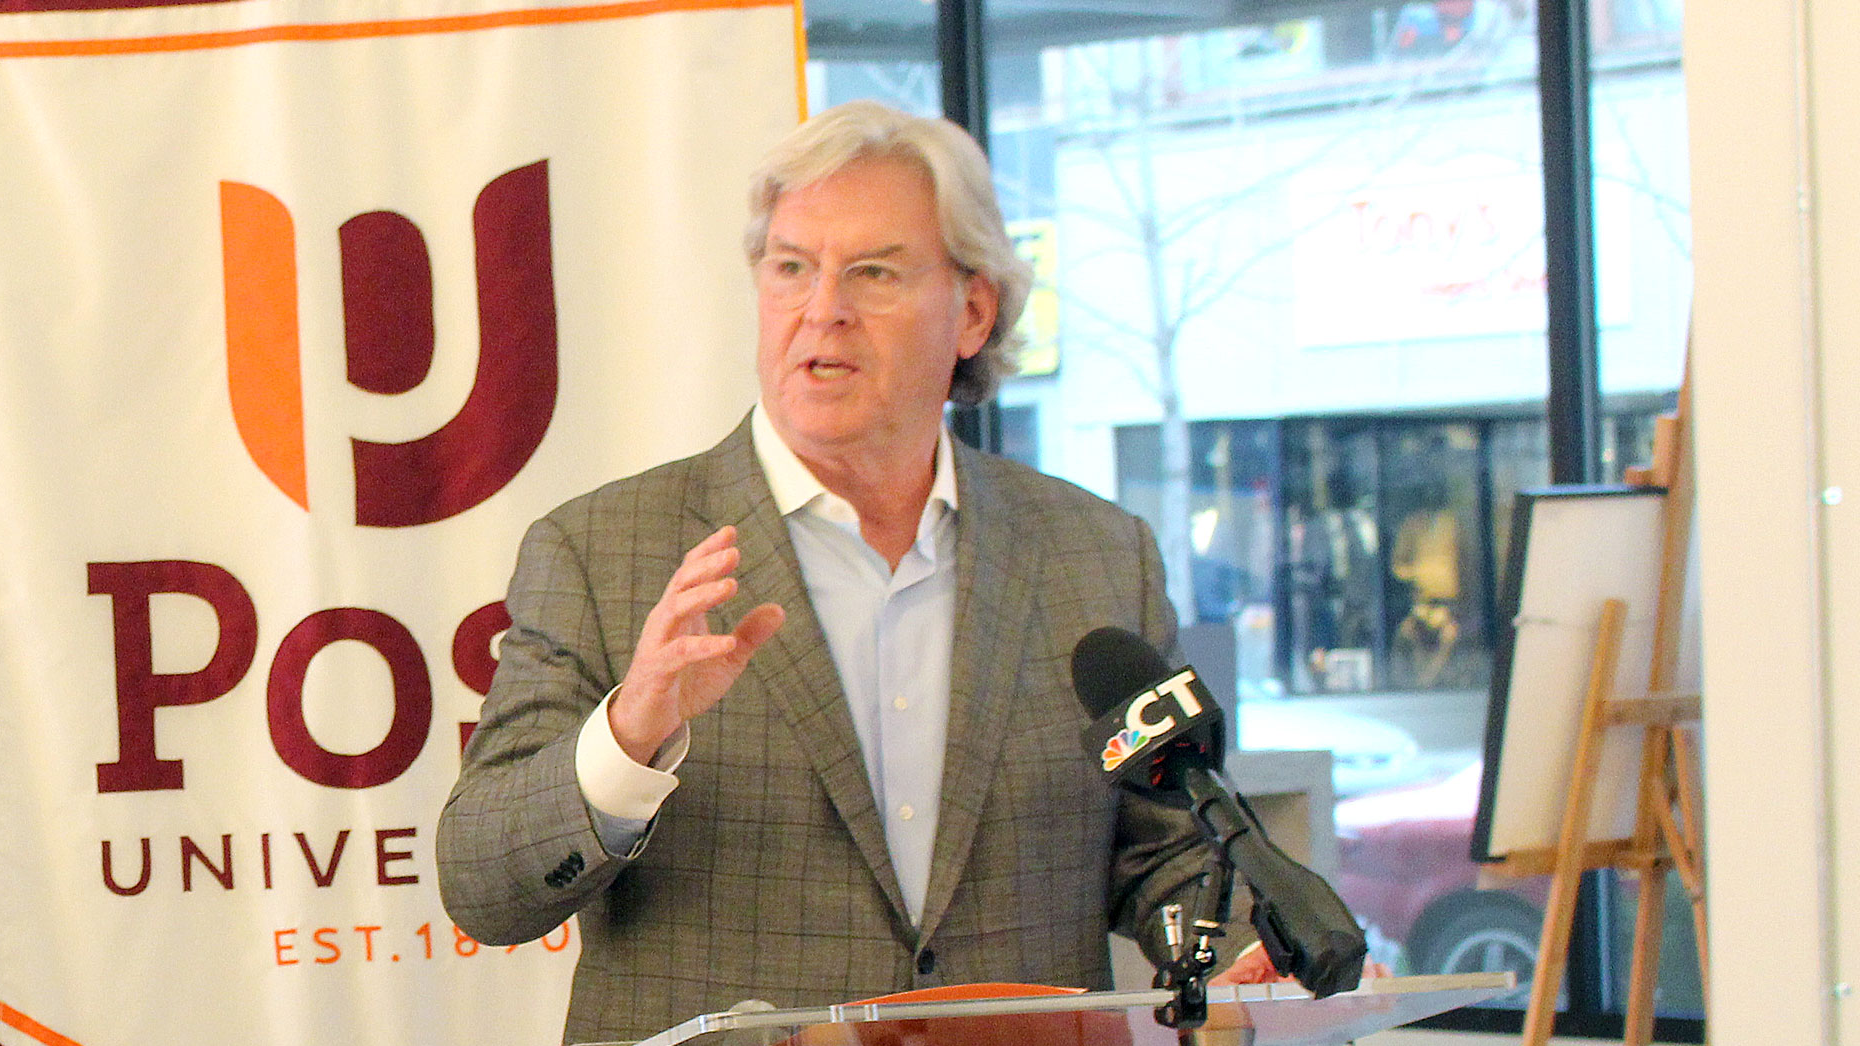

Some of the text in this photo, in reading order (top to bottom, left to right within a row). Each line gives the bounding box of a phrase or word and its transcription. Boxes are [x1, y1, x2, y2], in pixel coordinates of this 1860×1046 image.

[1125, 669, 1203, 739] CT
[102, 827, 419, 896] UNIVE
[274, 921, 570, 966] EST.180
